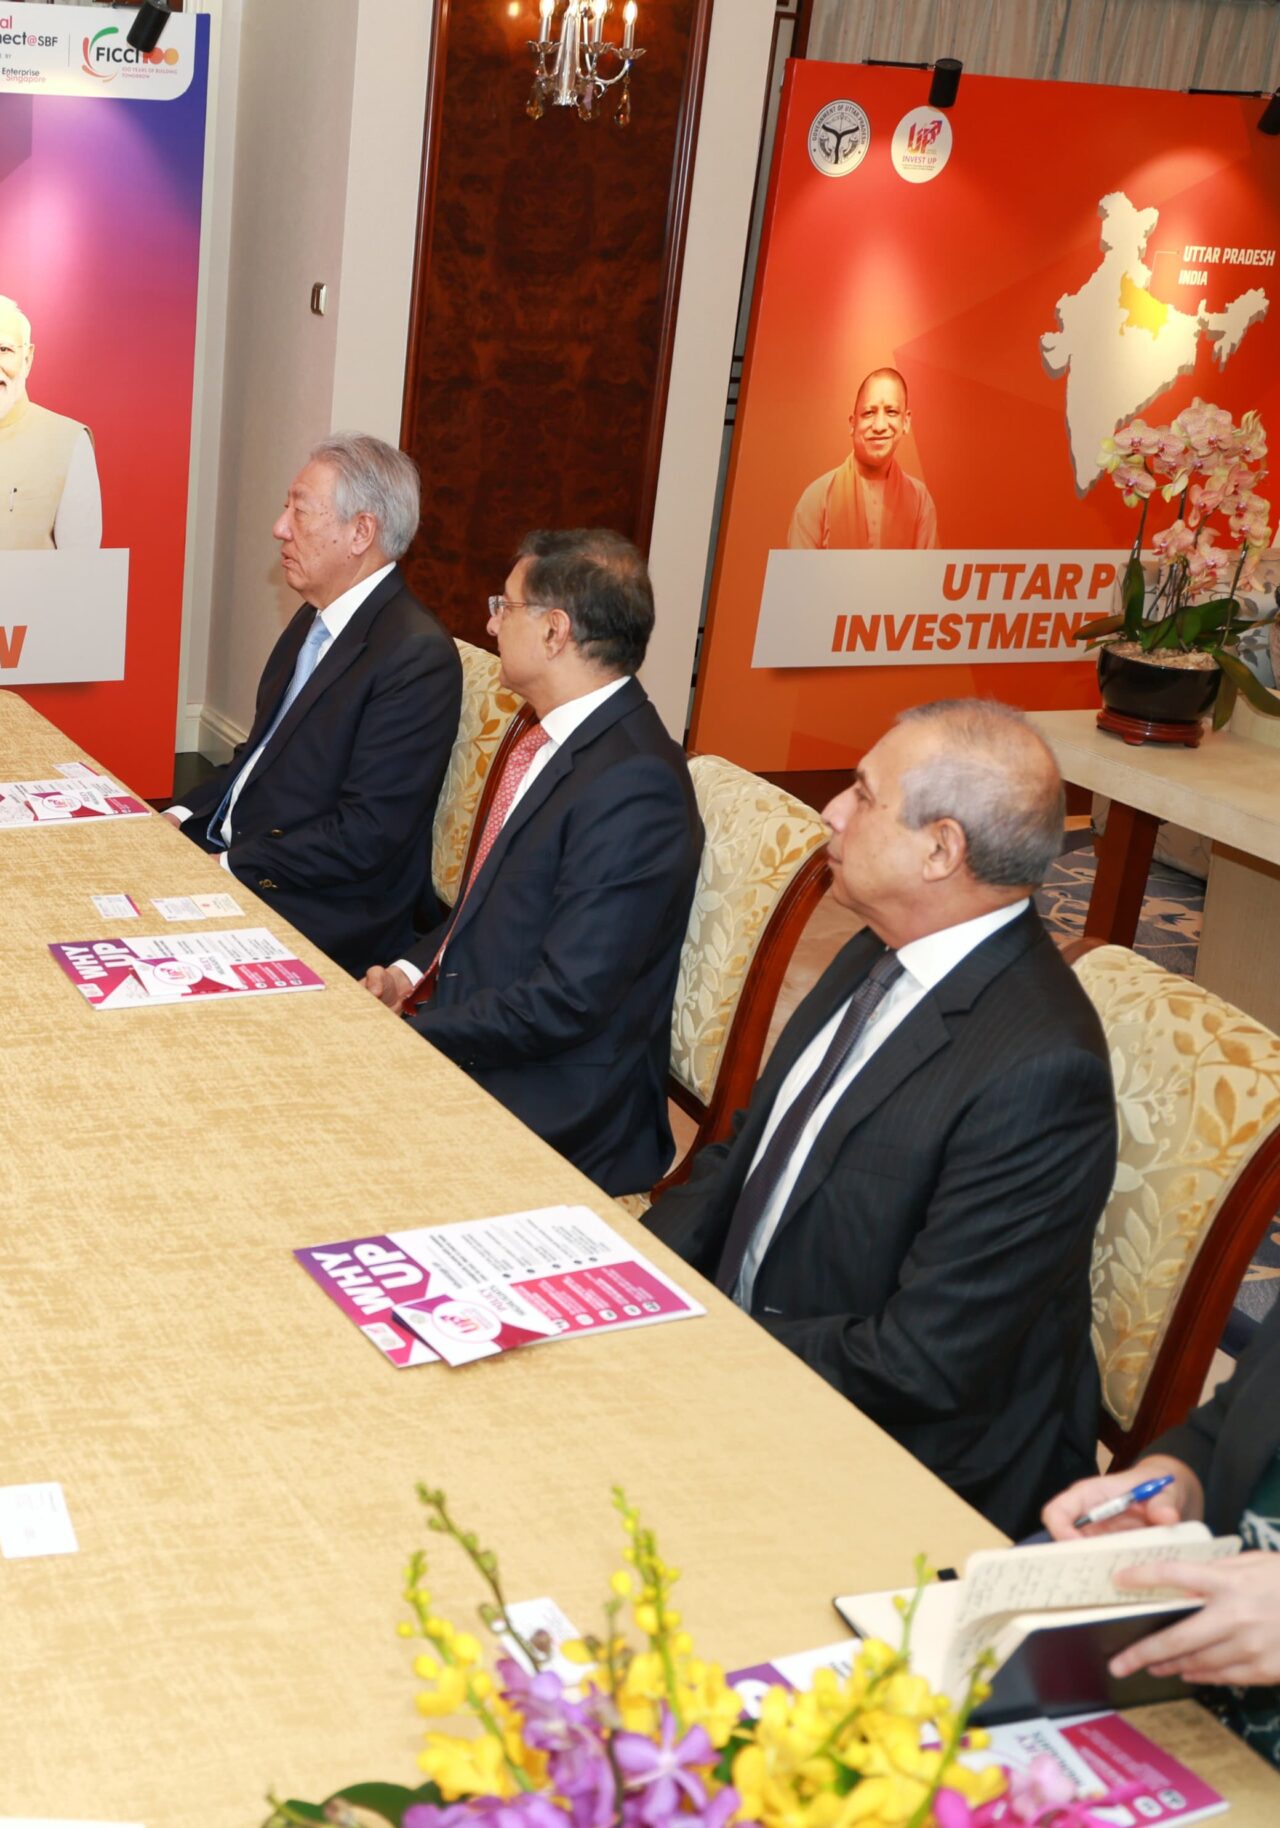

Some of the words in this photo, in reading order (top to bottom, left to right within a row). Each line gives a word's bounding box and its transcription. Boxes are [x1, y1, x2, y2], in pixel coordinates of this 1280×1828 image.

[2, 67, 40, 77] Enterprise
[902, 155, 926, 164] INVEST
[927, 157, 937, 165] UP
[1183, 245, 1221, 263] UTTAR
[1222, 247, 1276, 266] PRADESH
[1178, 270, 1208, 286] INDIA
[942, 563, 1083, 601] UTTAR
[61, 945, 109, 980] WHY
[92, 943, 136, 968] UP
[354, 1243, 424, 1289] UP
[310, 1252, 396, 1316] WHY
